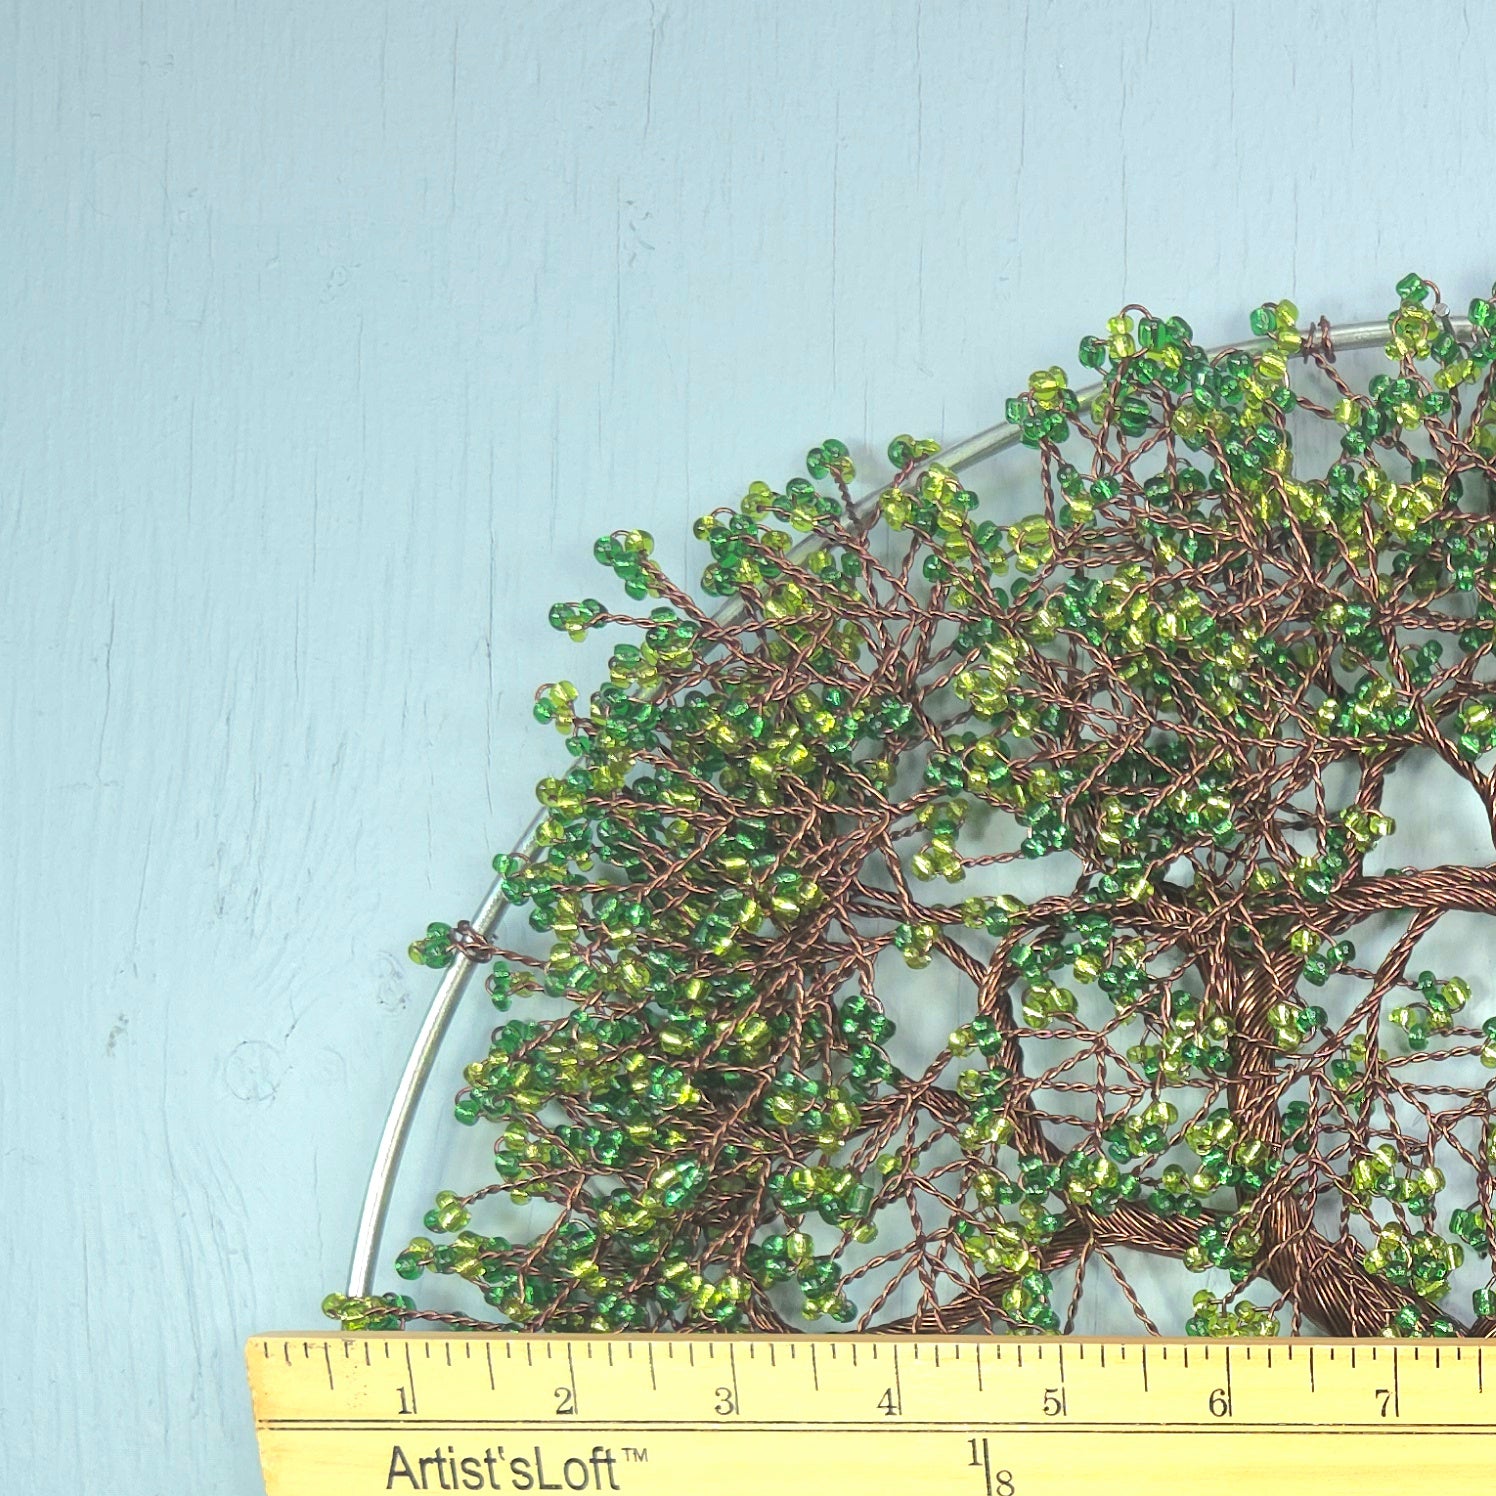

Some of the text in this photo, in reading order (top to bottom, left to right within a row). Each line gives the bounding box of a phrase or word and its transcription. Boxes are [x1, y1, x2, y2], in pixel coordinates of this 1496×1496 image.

[398, 1388, 411, 1414] 1
[555, 1388, 574, 1415] 2
[715, 1388, 735, 1415] 3
[876, 1388, 899, 1416] 4
[1043, 1388, 1062, 1416] 5
[1209, 1389, 1228, 1417] 6
[1376, 1389, 1395, 1417] 7
